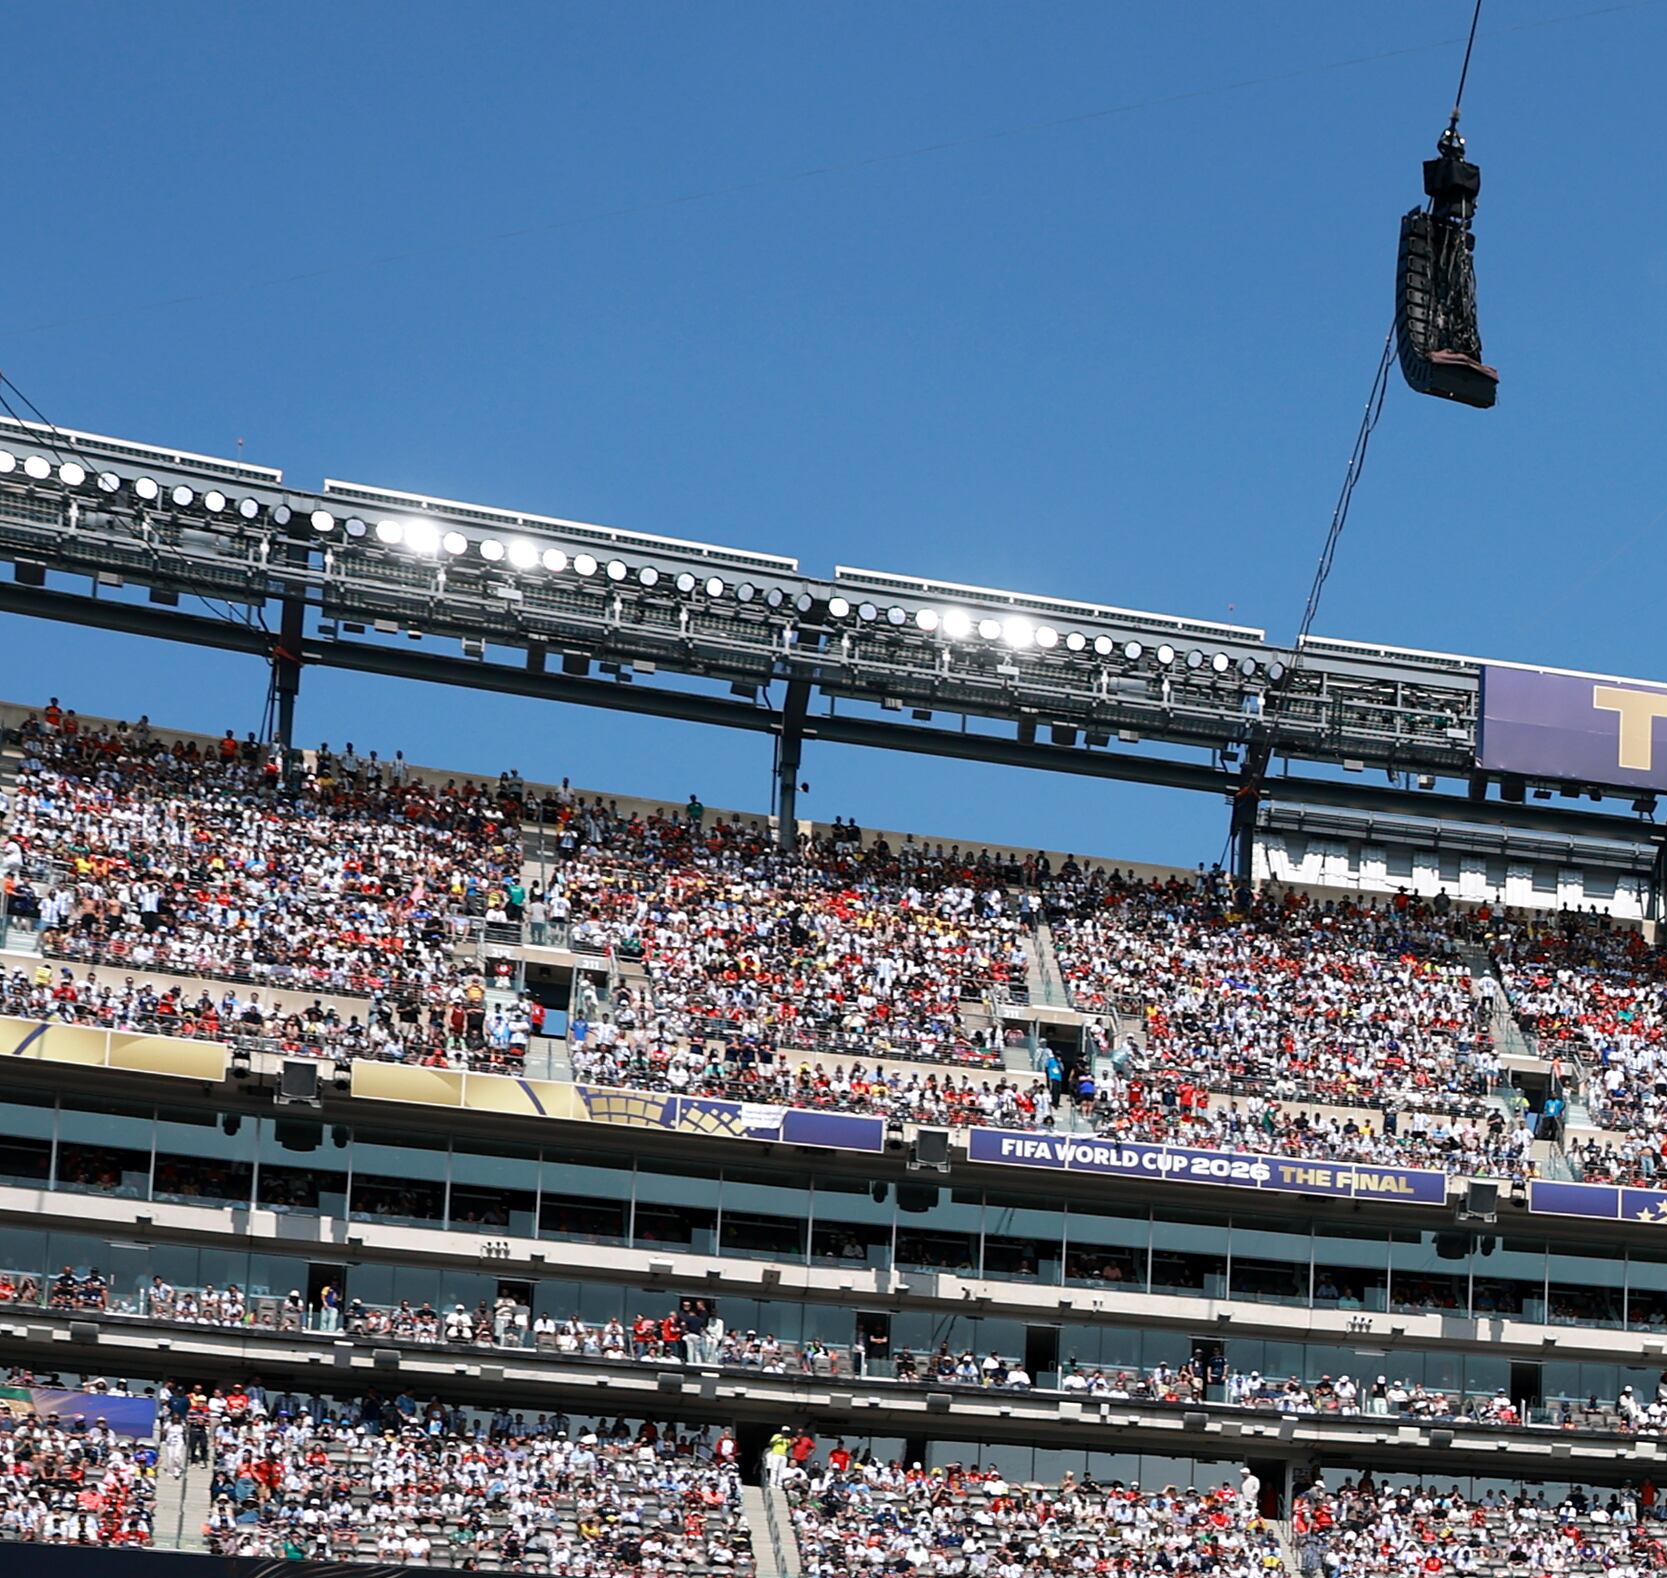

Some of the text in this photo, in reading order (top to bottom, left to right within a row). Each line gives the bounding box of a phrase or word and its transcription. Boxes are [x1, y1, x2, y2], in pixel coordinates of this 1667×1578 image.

[1001, 1138, 1415, 1194] FIFA WORLD CUP 2026 THE FINAL
